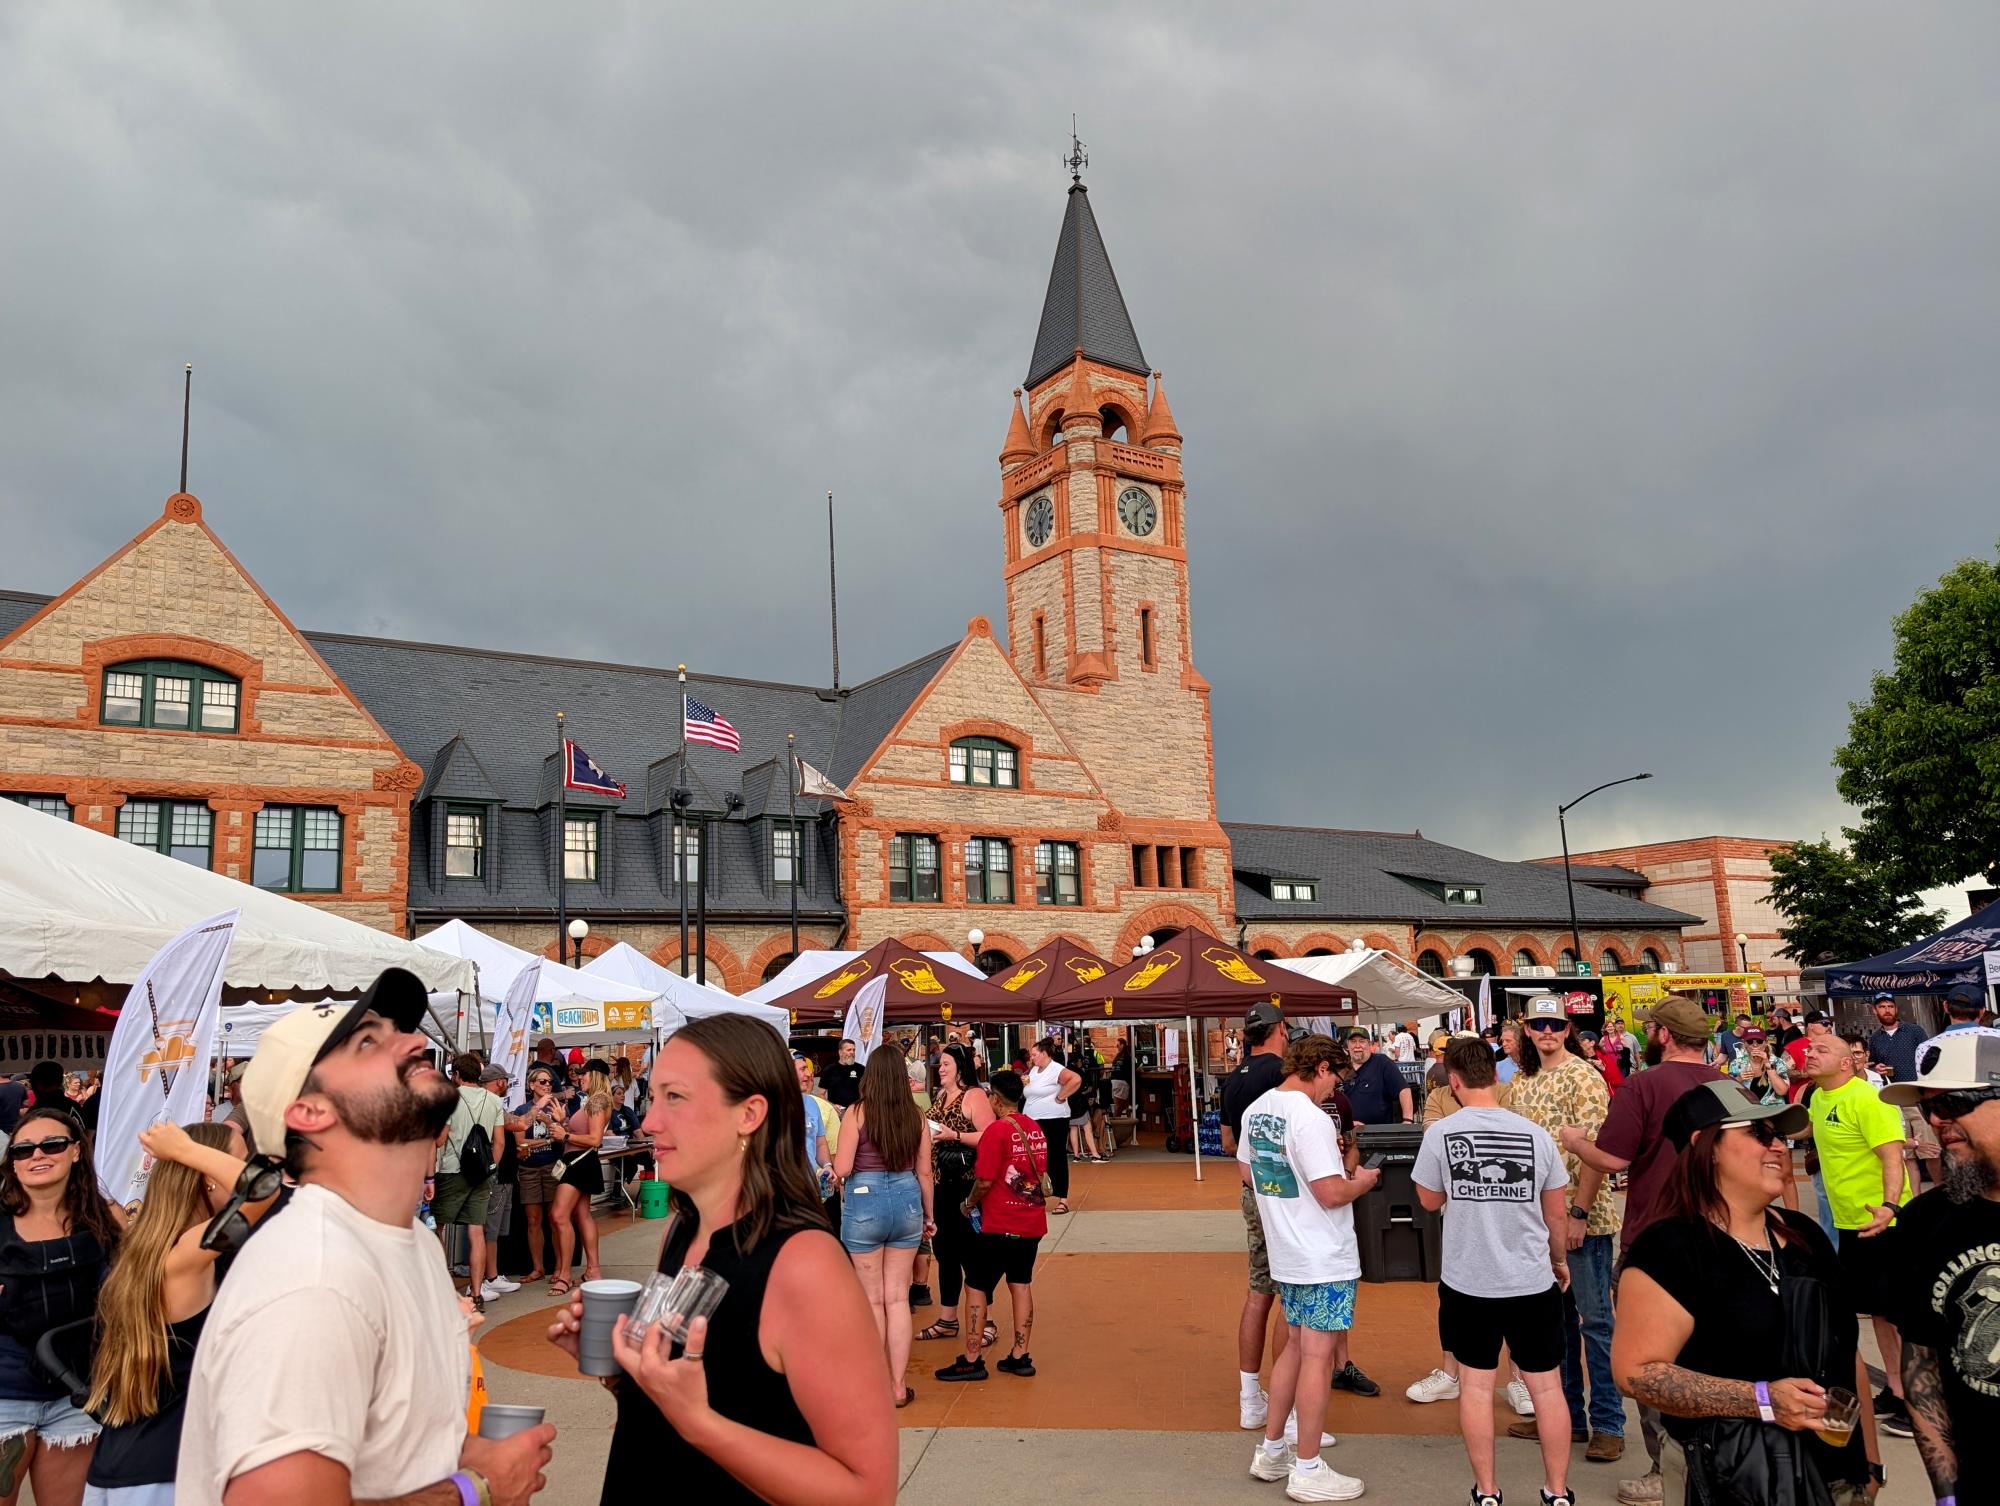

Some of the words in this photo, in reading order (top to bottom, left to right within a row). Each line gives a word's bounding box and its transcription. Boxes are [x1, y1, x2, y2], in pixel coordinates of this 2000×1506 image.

[1578, 964, 1585, 976] P
[1988, 963, 2000, 974] Be
[1458, 1185, 1527, 1198] CHEYENNE
[1931, 1243, 2000, 1315] ROLLING
